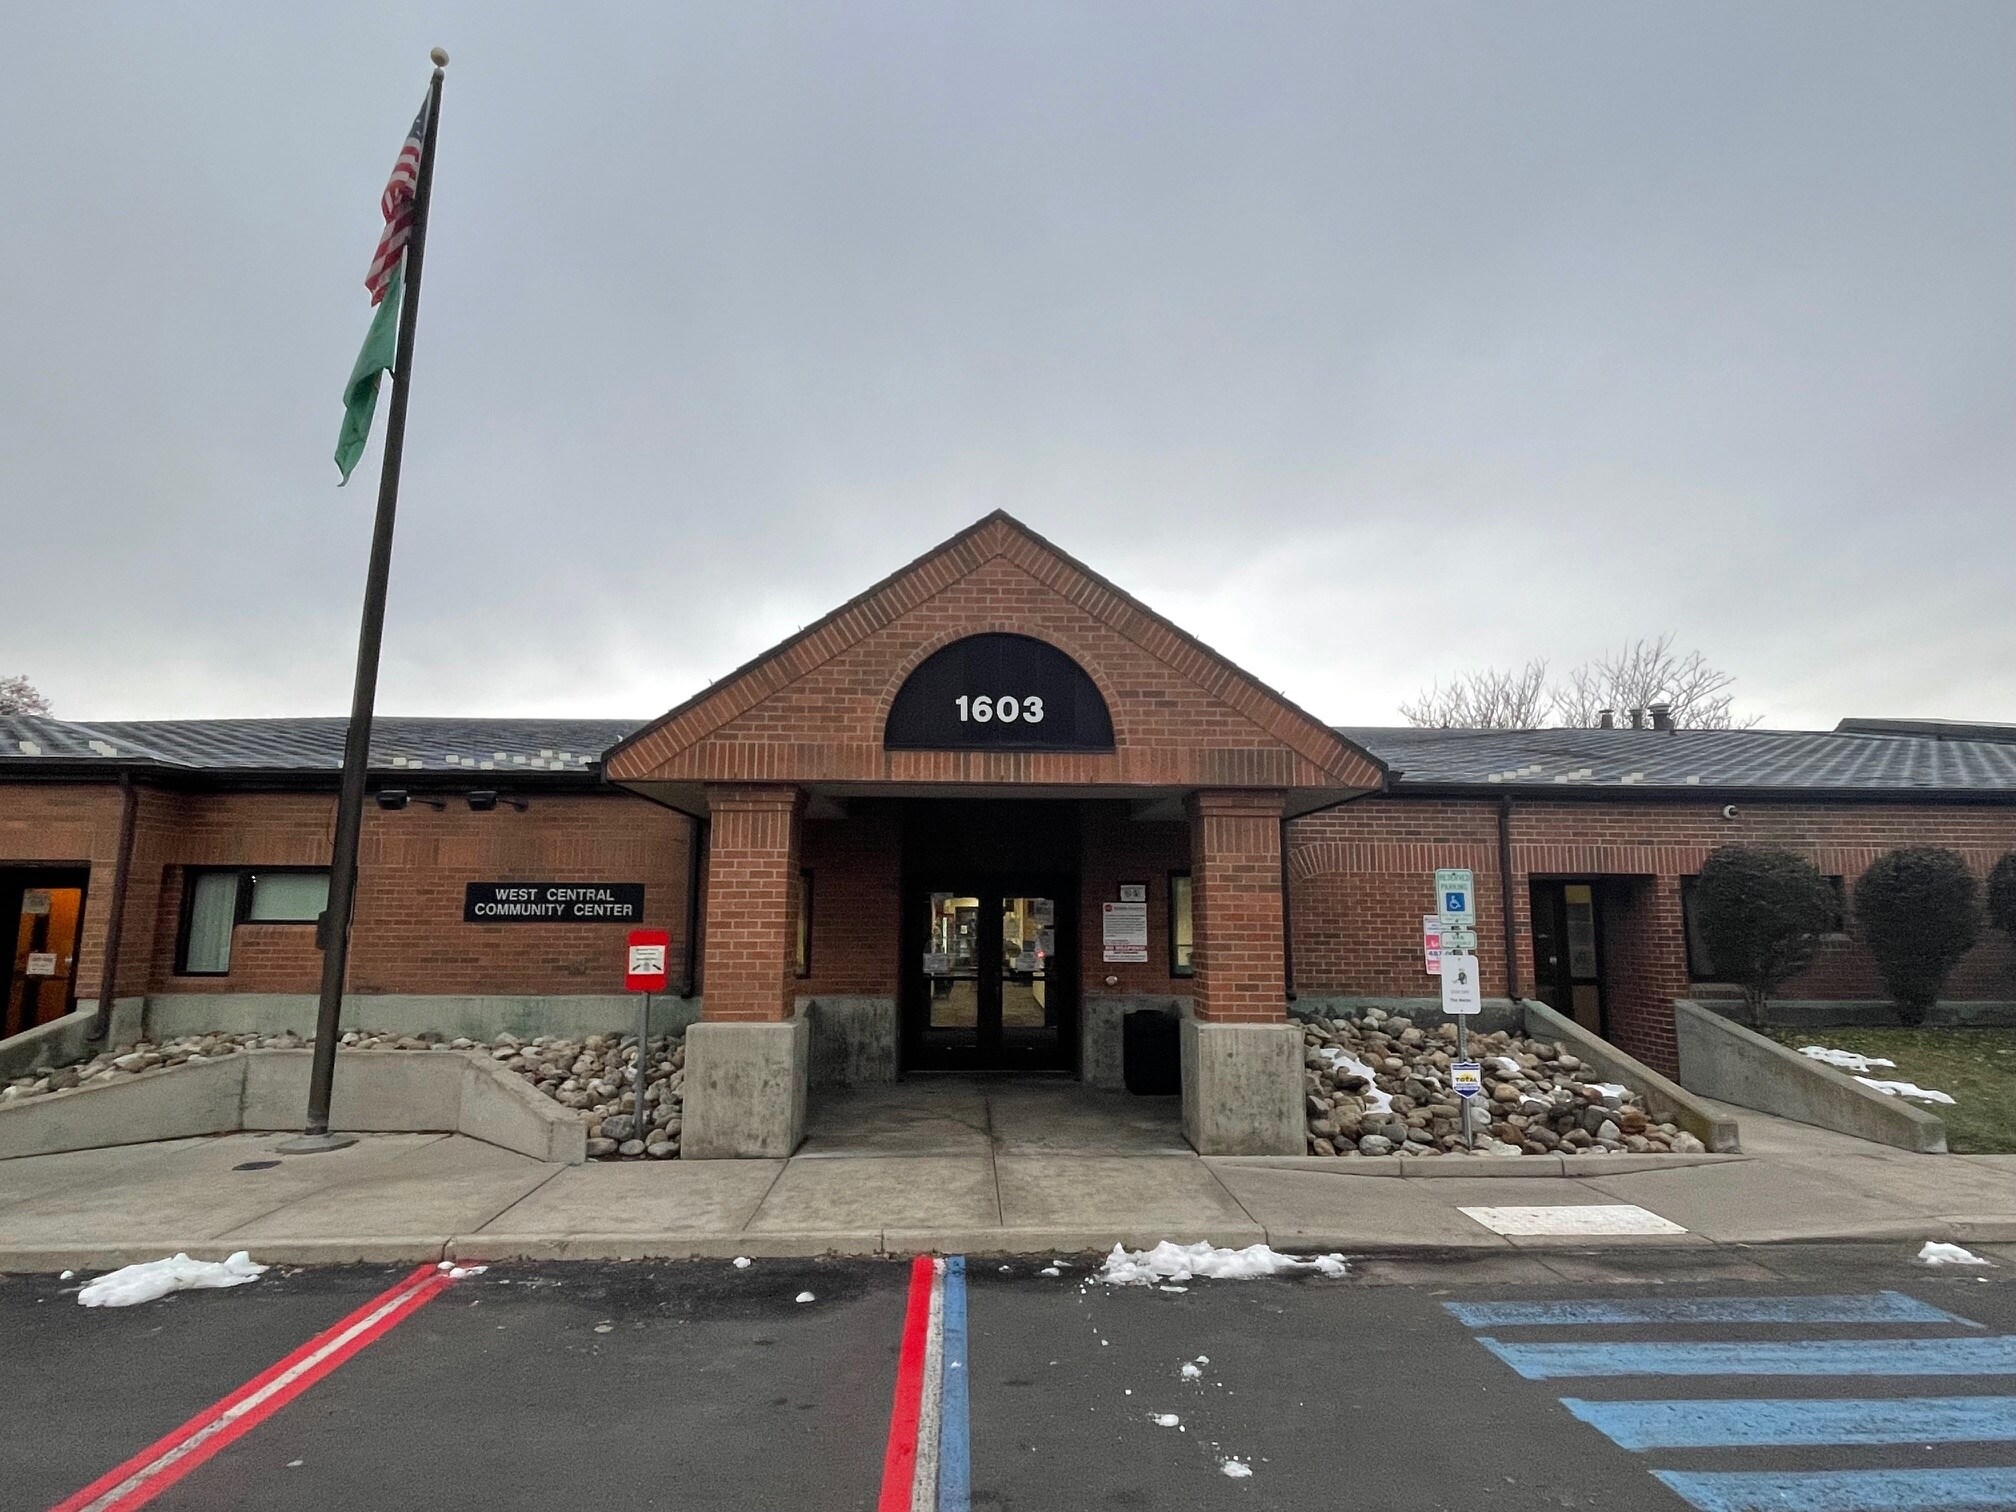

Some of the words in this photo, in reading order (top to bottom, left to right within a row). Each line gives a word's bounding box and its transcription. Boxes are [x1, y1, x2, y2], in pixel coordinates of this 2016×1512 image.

[955, 695, 1044, 723] 1603
[495, 888, 538, 901] WEST
[546, 888, 615, 901] CENTRAL
[474, 903, 565, 916] COMMUNITY
[573, 904, 633, 916] CENTER
